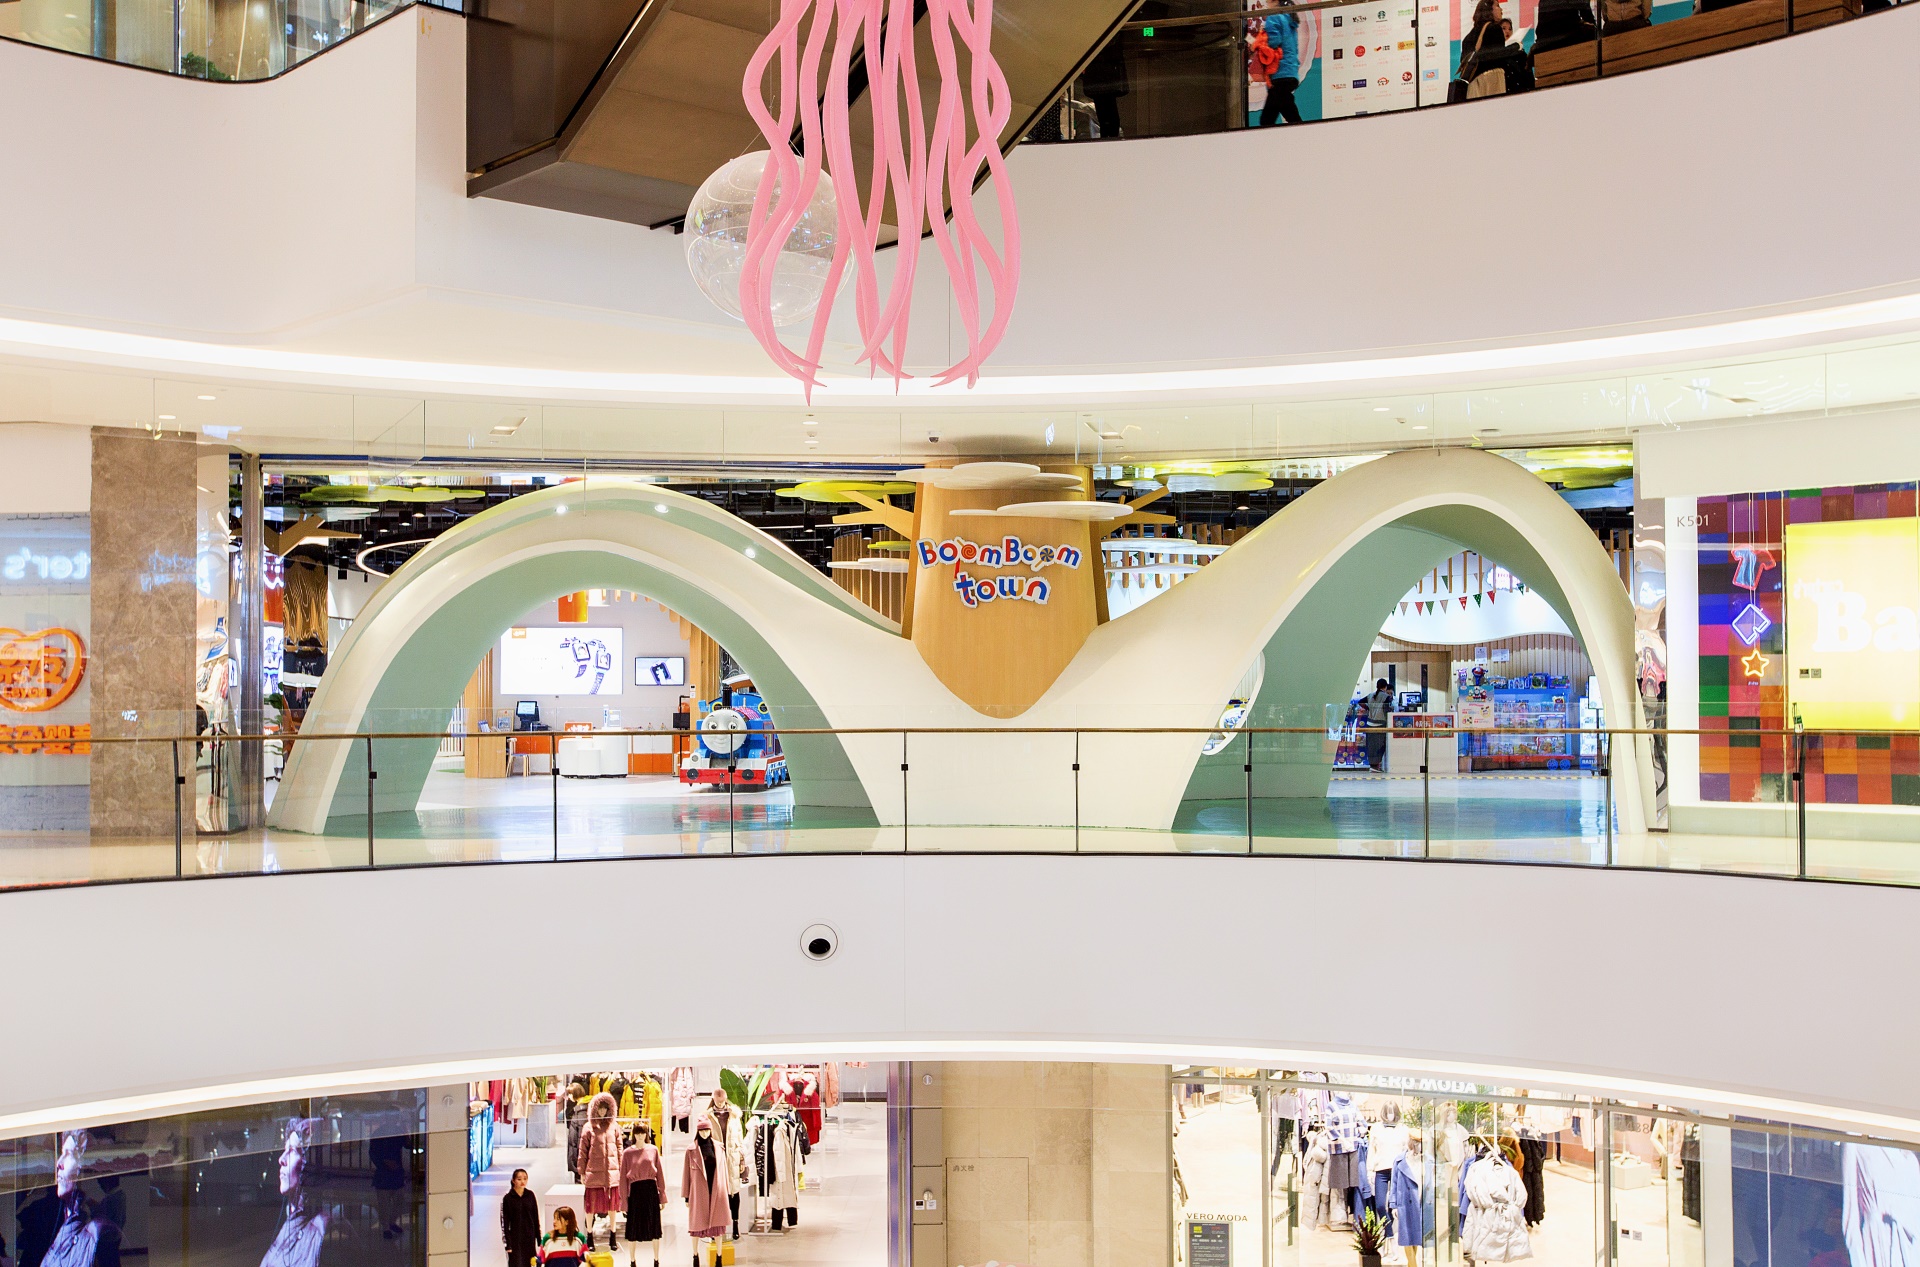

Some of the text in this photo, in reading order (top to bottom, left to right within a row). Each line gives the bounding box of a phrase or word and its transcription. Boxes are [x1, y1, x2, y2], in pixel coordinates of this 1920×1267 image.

[1676, 513, 1710, 528] K501
[953, 572, 1051, 608] town
[1186, 1212, 1248, 1222] VERO MODA
